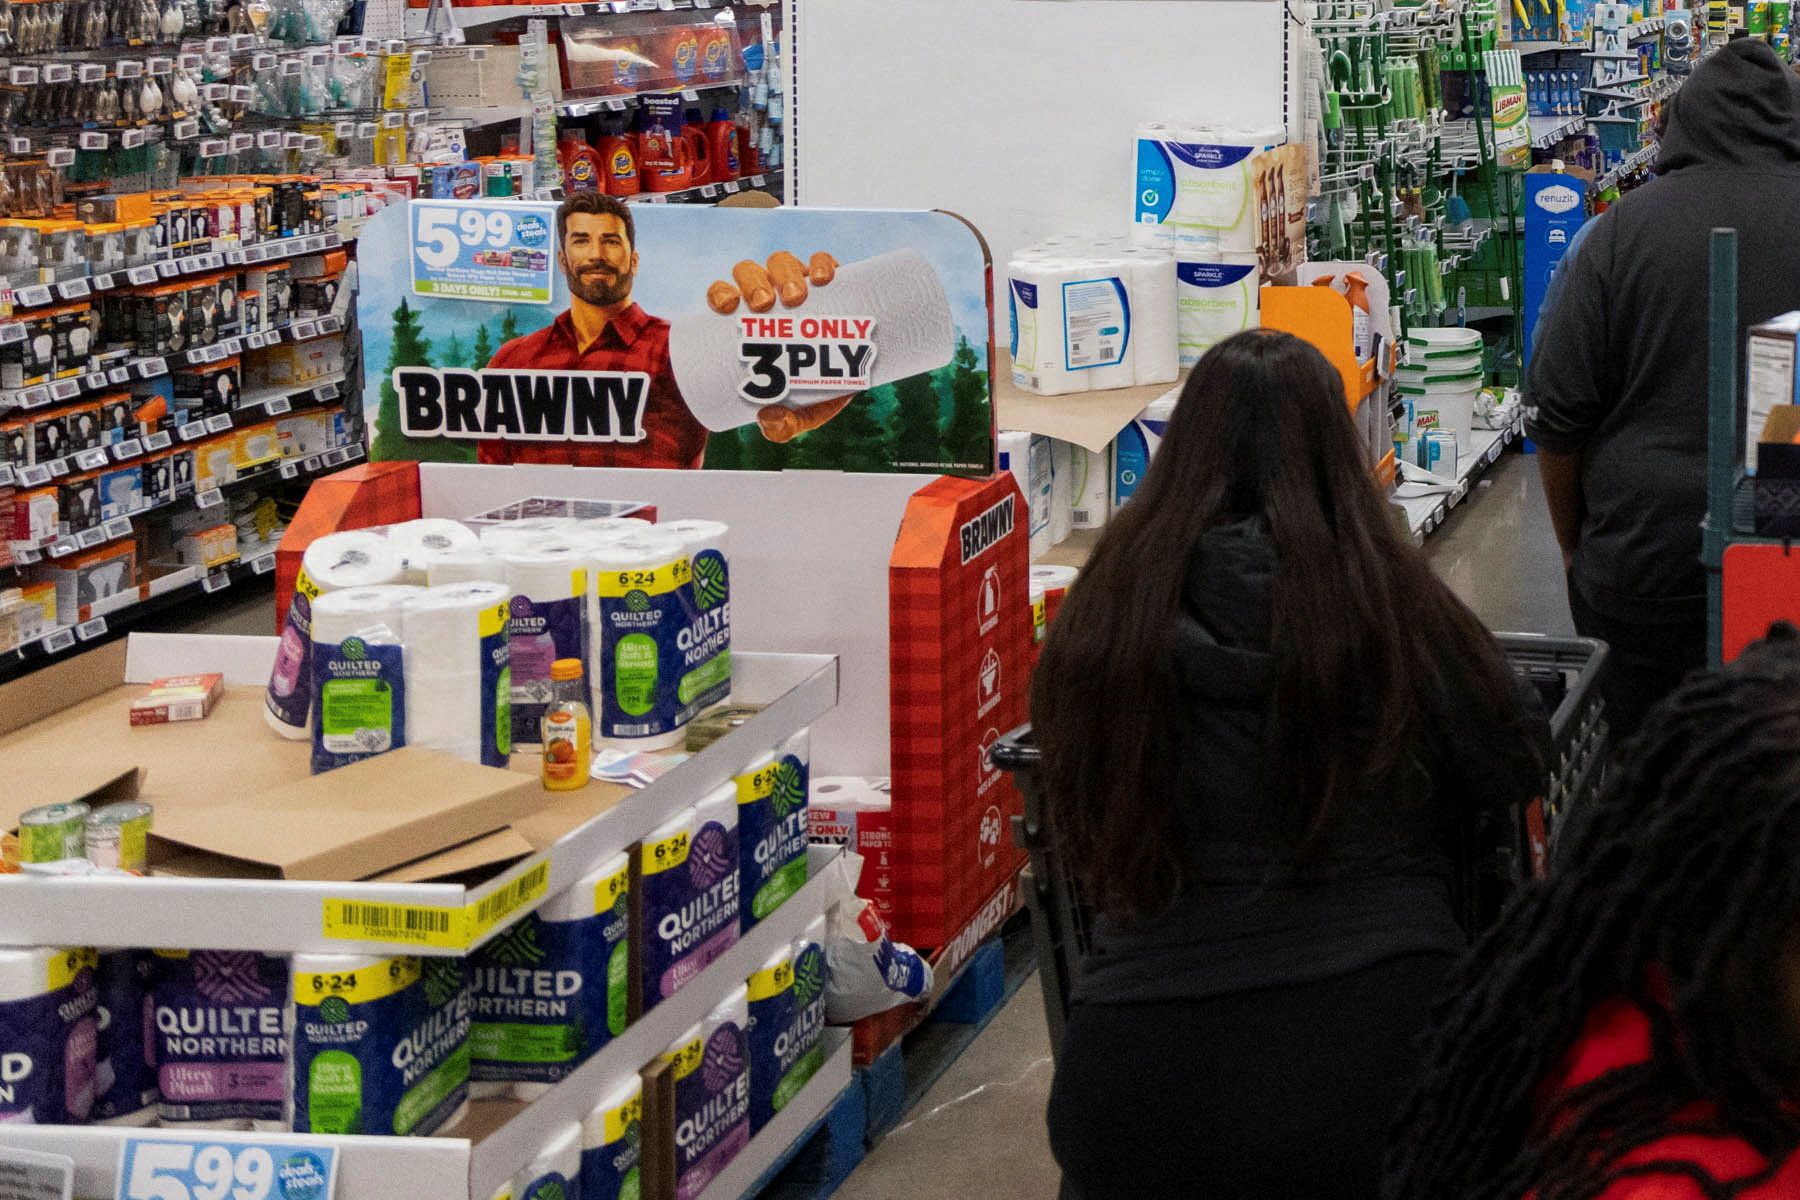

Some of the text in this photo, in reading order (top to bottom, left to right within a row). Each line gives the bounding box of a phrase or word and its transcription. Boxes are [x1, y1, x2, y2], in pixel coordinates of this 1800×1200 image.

[1495, 95, 1521, 112] LIBMAN
[614, 157, 632, 168] Tide
[1540, 194, 1574, 202] renuzit
[1193, 270, 1222, 279] SPARKLE
[742, 318, 870, 339] THE ONLY
[400, 372, 643, 438] BRAWNY
[962, 497, 1013, 562] BRAWNY
[611, 611, 661, 622] QUILTED
[615, 620, 658, 628] NORTHERN
[328, 661, 381, 671] QUILTED
[820, 826, 848, 835] ONLY
[305, 1022, 369, 1037] QUILTED
